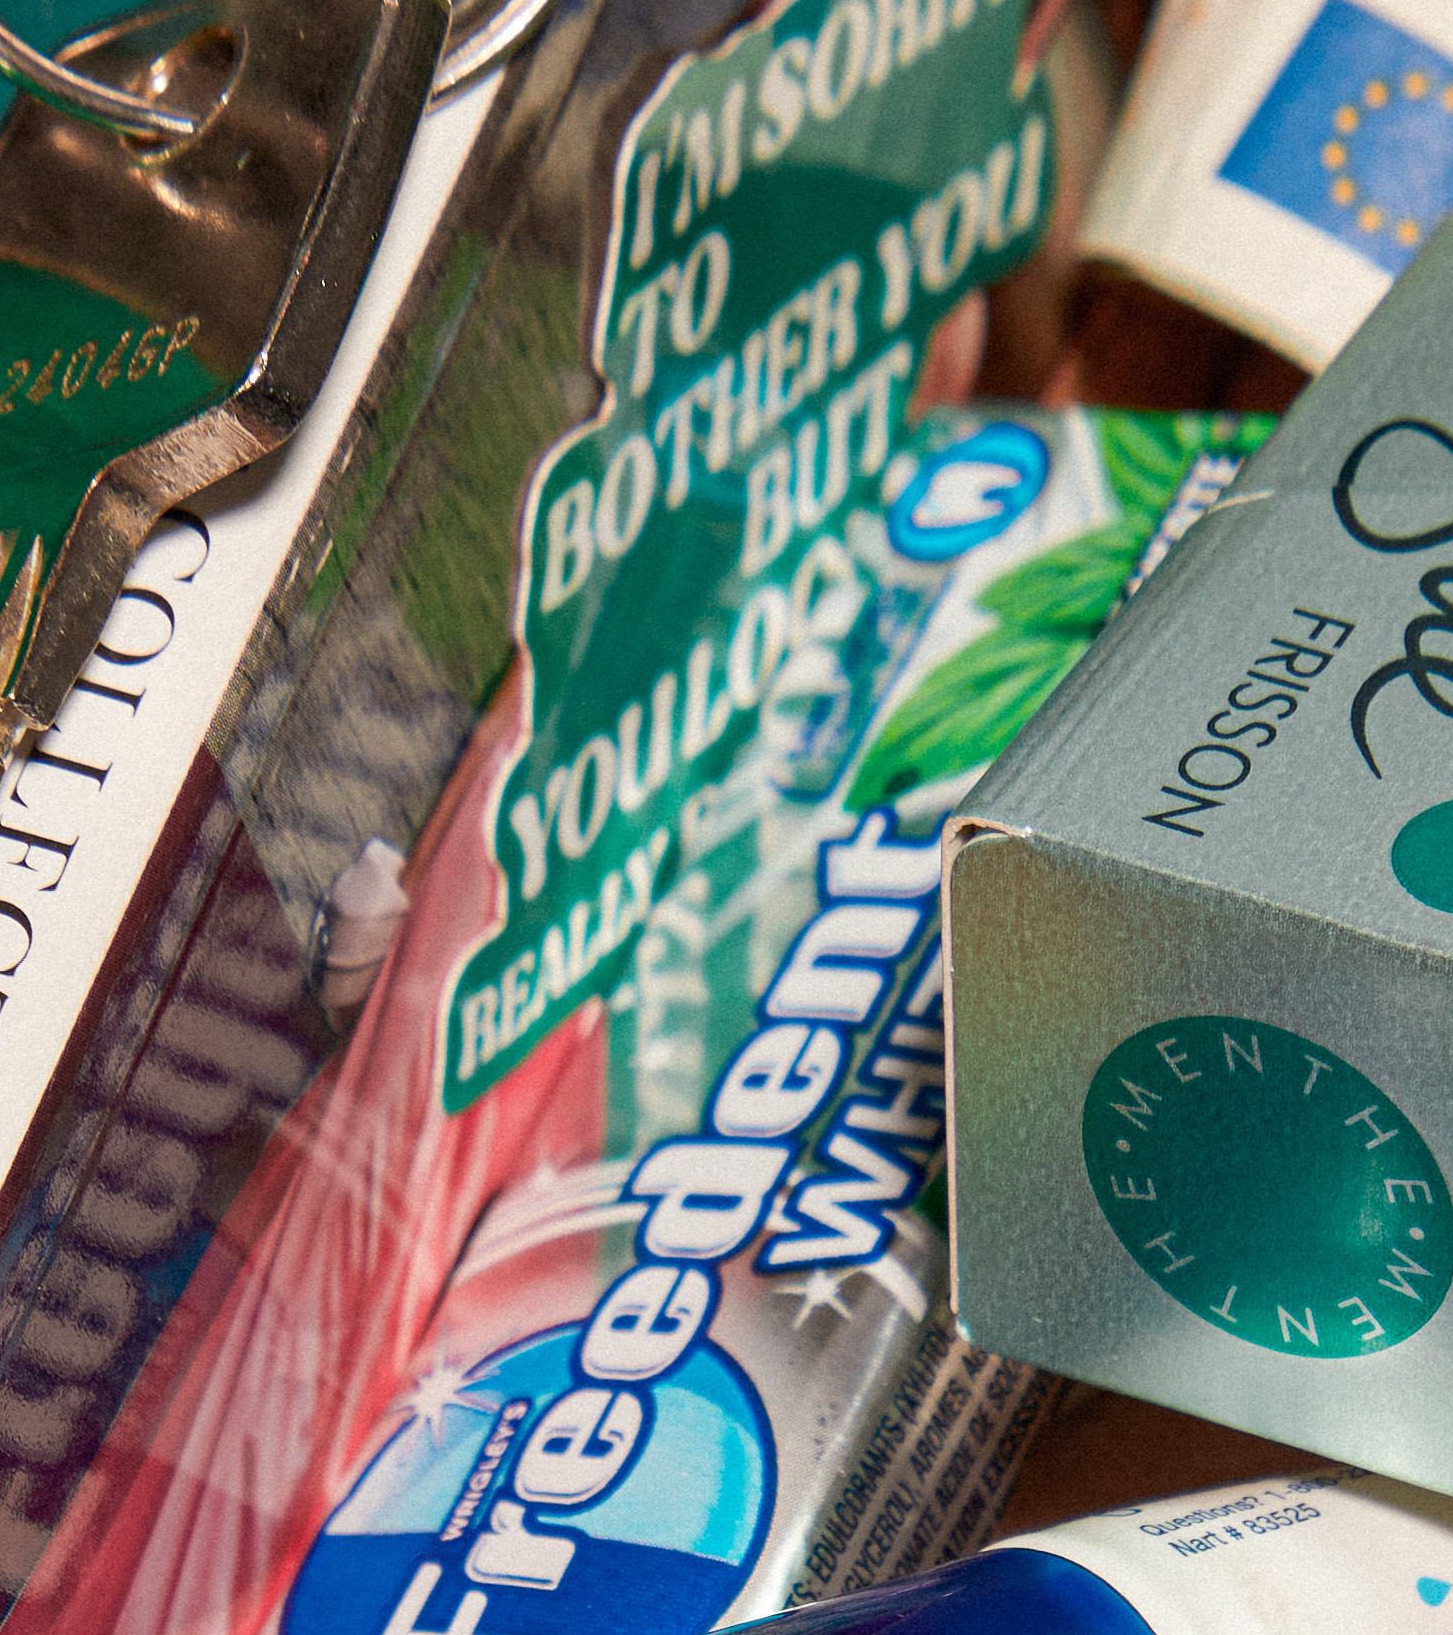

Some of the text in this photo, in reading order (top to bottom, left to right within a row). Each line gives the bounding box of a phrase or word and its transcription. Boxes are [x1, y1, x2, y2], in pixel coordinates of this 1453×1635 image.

[540, 260, 861, 614] BOTHER
[876, 115, 1047, 330] YOU
[617, 231, 732, 397] TO
[741, 339, 913, 575] BUT
[508, 672, 677, 901] YOU
[1140, 607, 1355, 840] FRISSON
[458, 825, 672, 1082] REALLY
[1107, 1030, 1437, 1207] MENTHE
[1107, 1170, 1437, 1351] MENTHE
[440, 1396, 533, 1545] WRIGLEY'S
[806, 1413, 908, 1586] EDULCORANTS
[1138, 1495, 1265, 1538] Questions?
[1167, 1501, 1323, 1558] Nart # 83525
